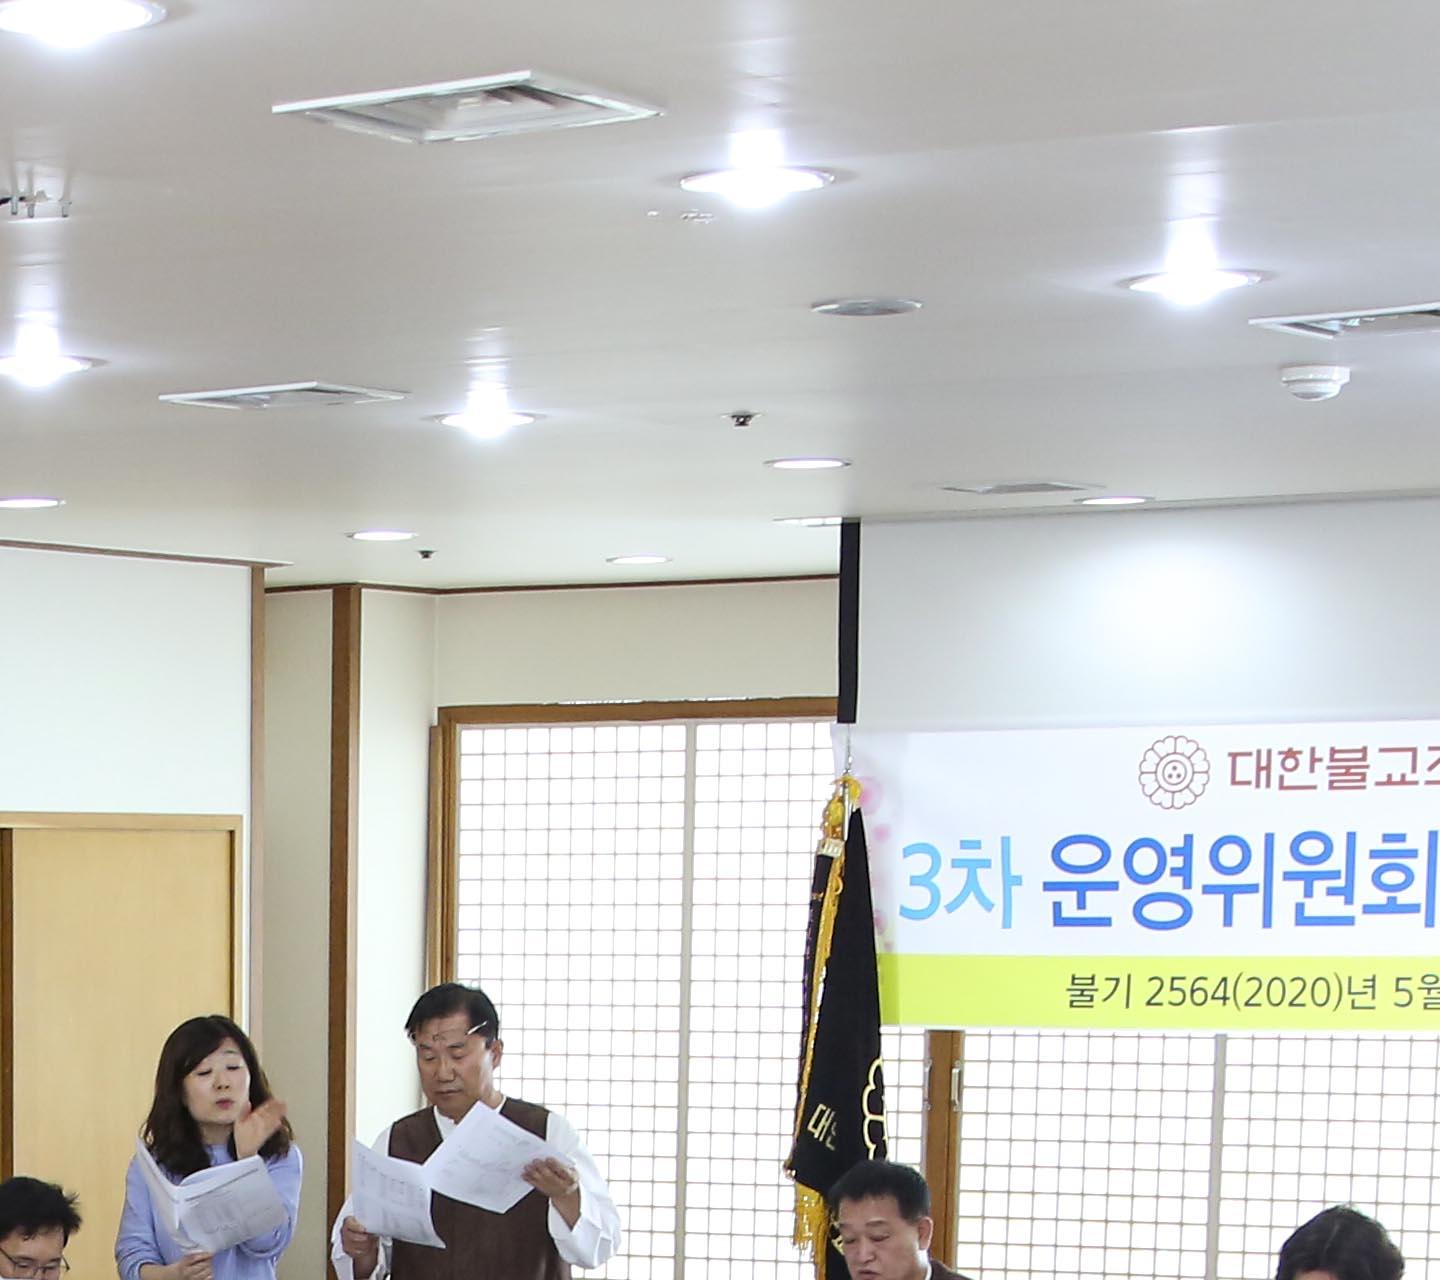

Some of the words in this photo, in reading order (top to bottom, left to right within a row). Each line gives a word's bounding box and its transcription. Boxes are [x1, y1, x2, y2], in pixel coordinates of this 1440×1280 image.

[899, 836, 1022, 929] 3차
[1065, 973, 1132, 1009] 불기
[1145, 972, 1378, 1012] 2564(2020)년
